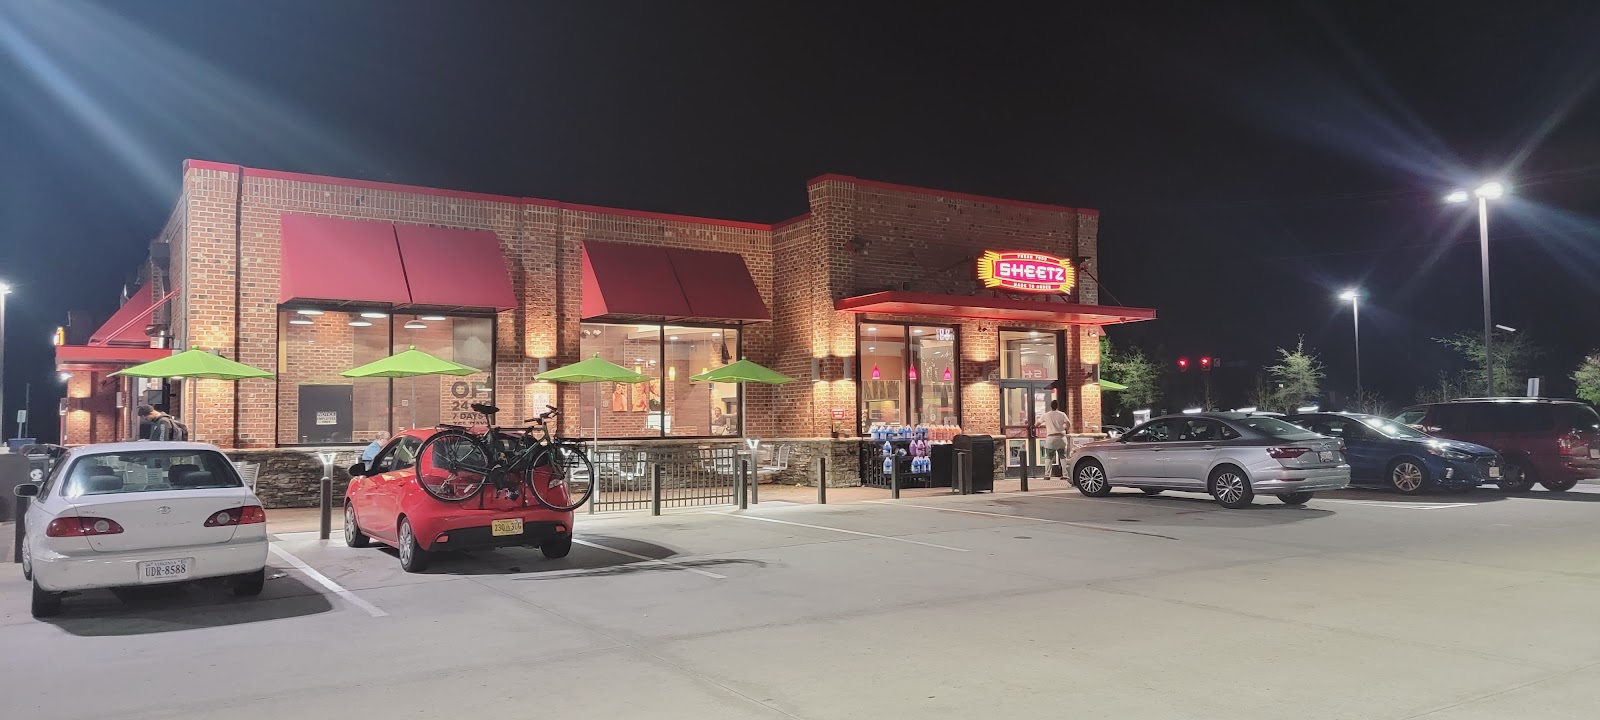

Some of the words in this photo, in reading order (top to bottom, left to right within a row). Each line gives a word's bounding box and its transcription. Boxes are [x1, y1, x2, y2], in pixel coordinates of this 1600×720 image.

[1000, 263, 1064, 280] SHEETZ
[452, 401, 469, 411] 24
[452, 412, 458, 420] 7
[460, 412, 483, 420] DAYS
[145, 564, 186, 577] UDR-8588
